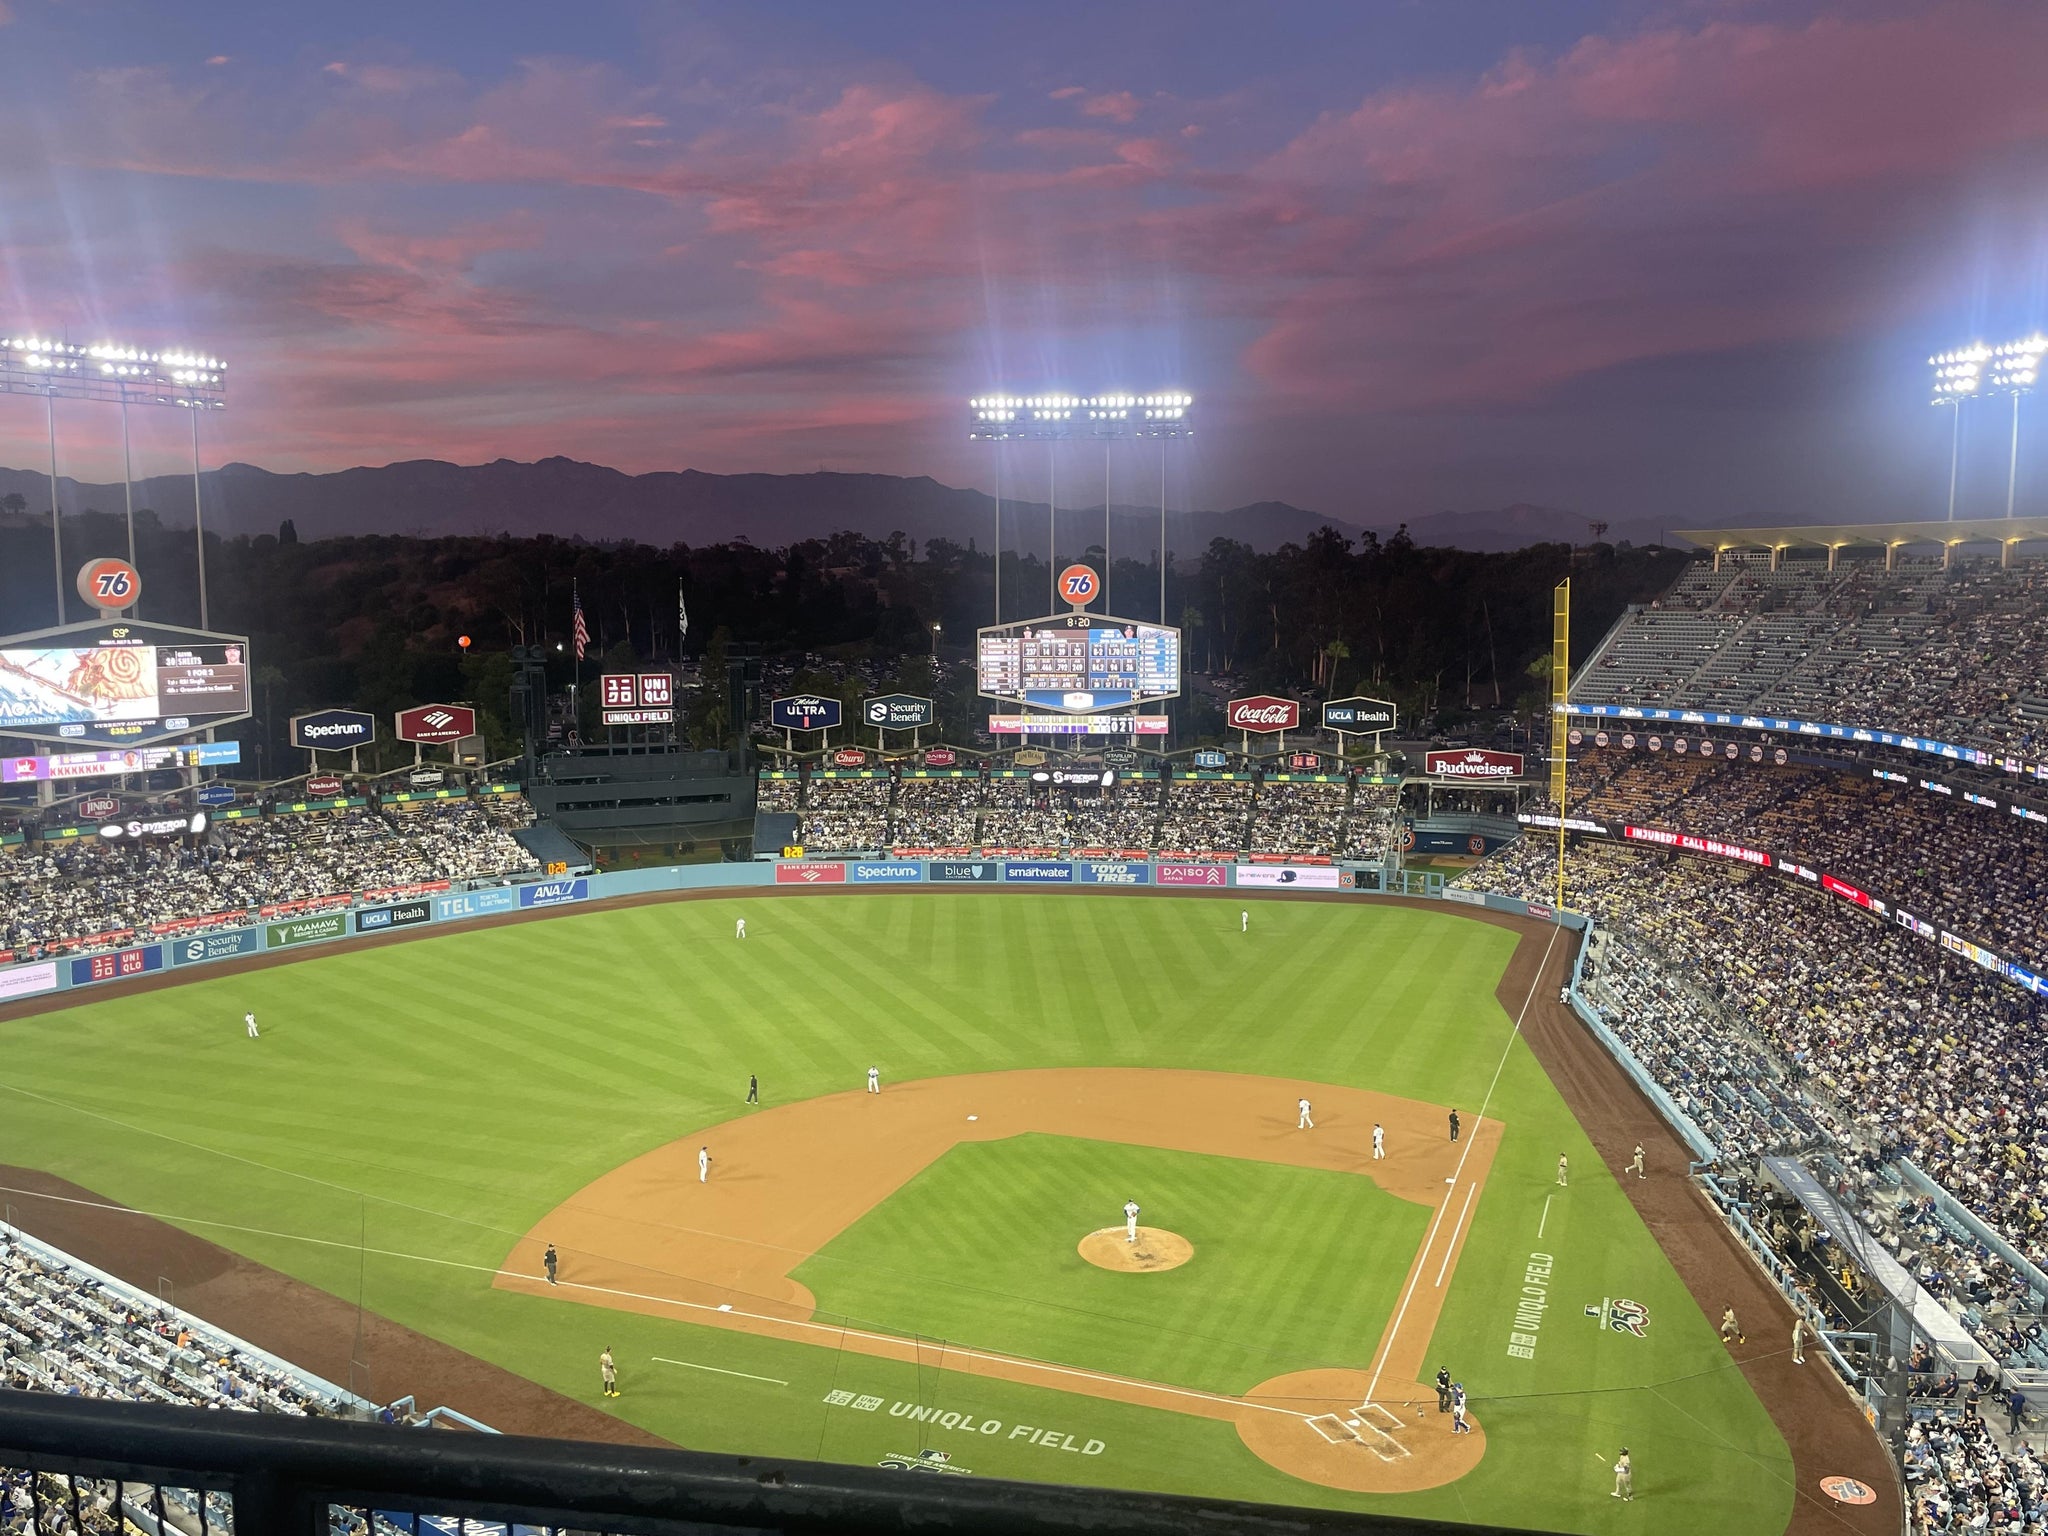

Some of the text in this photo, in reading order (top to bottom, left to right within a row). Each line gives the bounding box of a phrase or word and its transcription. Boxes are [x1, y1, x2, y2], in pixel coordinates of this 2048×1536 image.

[97, 571, 130, 597] 76
[1066, 574, 1091, 594] 76
[1067, 618, 1090, 627] 8:20
[112, 628, 129, 638] 69°
[644, 678, 666, 689] UNI
[645, 690, 668, 703] QLO
[787, 706, 826, 715] ULTRA
[890, 703, 926, 713] Security
[608, 712, 668, 722] UNIQLO FIELD
[890, 713, 921, 721] Benefit
[1234, 704, 1292, 724] Coca-Cola
[1329, 711, 1390, 721] UCLA Health
[304, 723, 362, 739] Spectrum
[836, 754, 863, 763] Churu
[1199, 754, 1222, 764] TEL
[87, 800, 114, 814] JINRO
[1472, 839, 1483, 850] 76
[1633, 828, 1678, 844] INJURED?
[1683, 837, 1705, 851] CALL
[784, 847, 803, 858] 0:28
[548, 862, 566, 875] 0:28
[858, 866, 912, 879] Spectrum
[945, 865, 971, 876] blue
[1009, 868, 1069, 877] smartwater
[1091, 865, 1127, 873] TOYO
[1164, 868, 1204, 876] DAISO
[1097, 874, 1136, 883] TIRES
[534, 885, 560, 898] ANA
[440, 898, 474, 916] TEL
[366, 908, 424, 924] UCLA Health
[208, 934, 243, 946] Security
[208, 944, 238, 956] Benefit
[122, 953, 139, 963] UNI
[123, 962, 141, 972] QLO
[1514, 1252, 1554, 1331] UNIQLO FIELD
[855, 1401, 876, 1410] QLO
[860, 1395, 880, 1405] UNI
[889, 1401, 1106, 1456] UNIQLO FIELD
[886, 1453, 933, 1465] CELEBRATING
